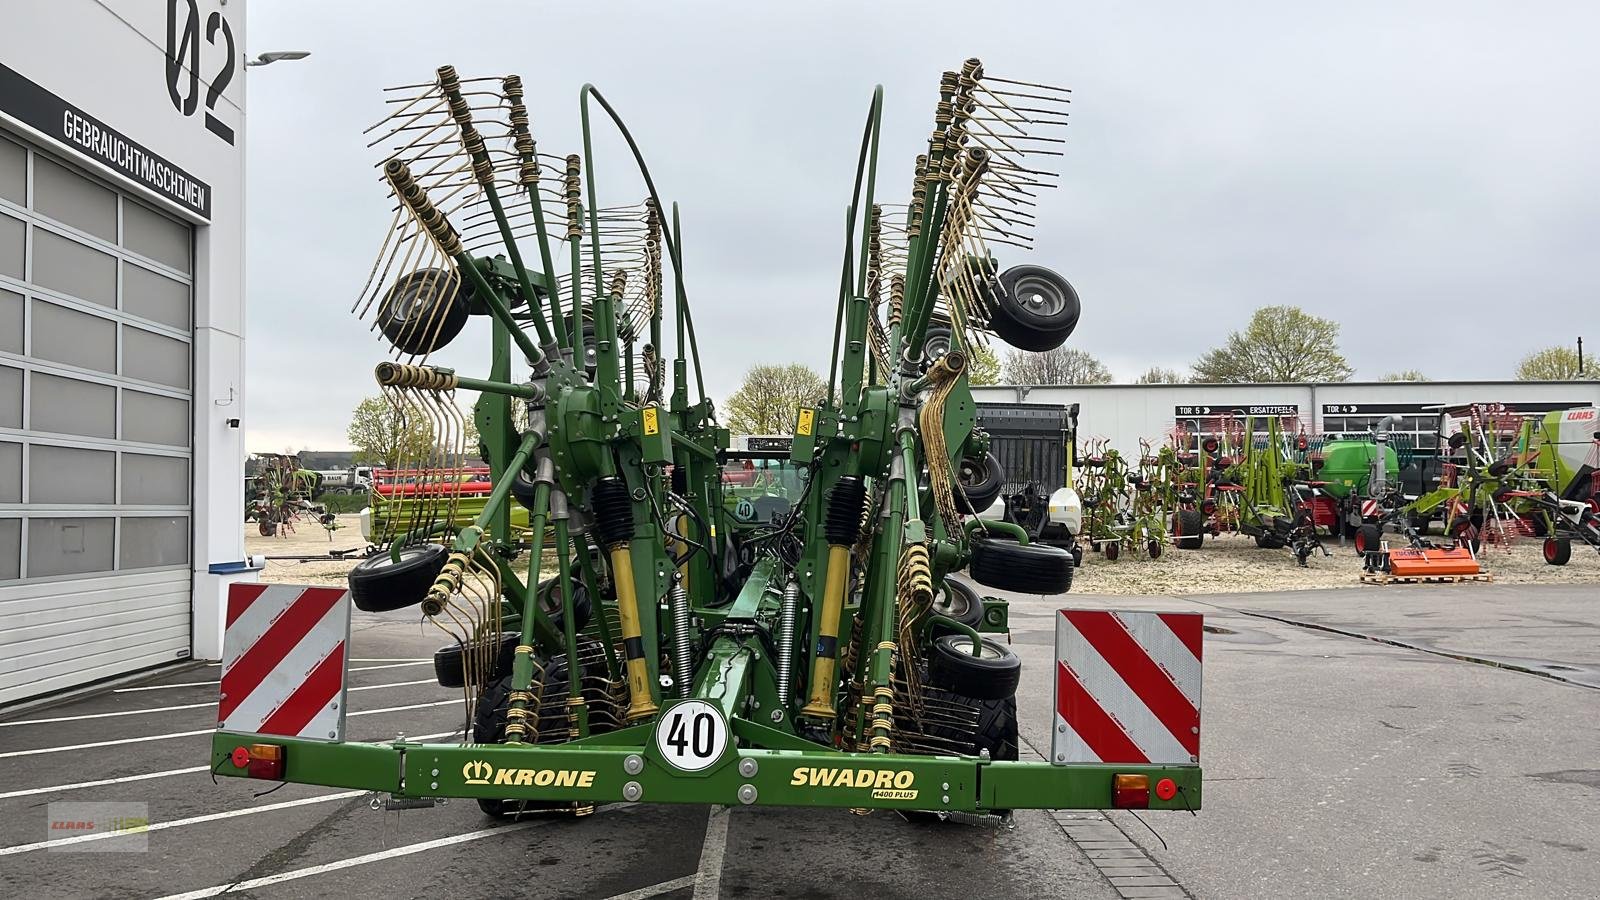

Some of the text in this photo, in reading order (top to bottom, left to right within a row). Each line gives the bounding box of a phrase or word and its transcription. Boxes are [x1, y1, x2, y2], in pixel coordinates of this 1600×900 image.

[63, 109, 205, 211] GEBRAUCHTMASCHINEN
[1180, 407, 1200, 415] TOR 5
[1326, 405, 1348, 413] TOR 4
[1567, 411, 1595, 421] CLAAS
[738, 503, 750, 516] 40
[666, 712, 715, 758] 40
[493, 768, 597, 787] KRONE
[790, 767, 914, 789] SWADRO
